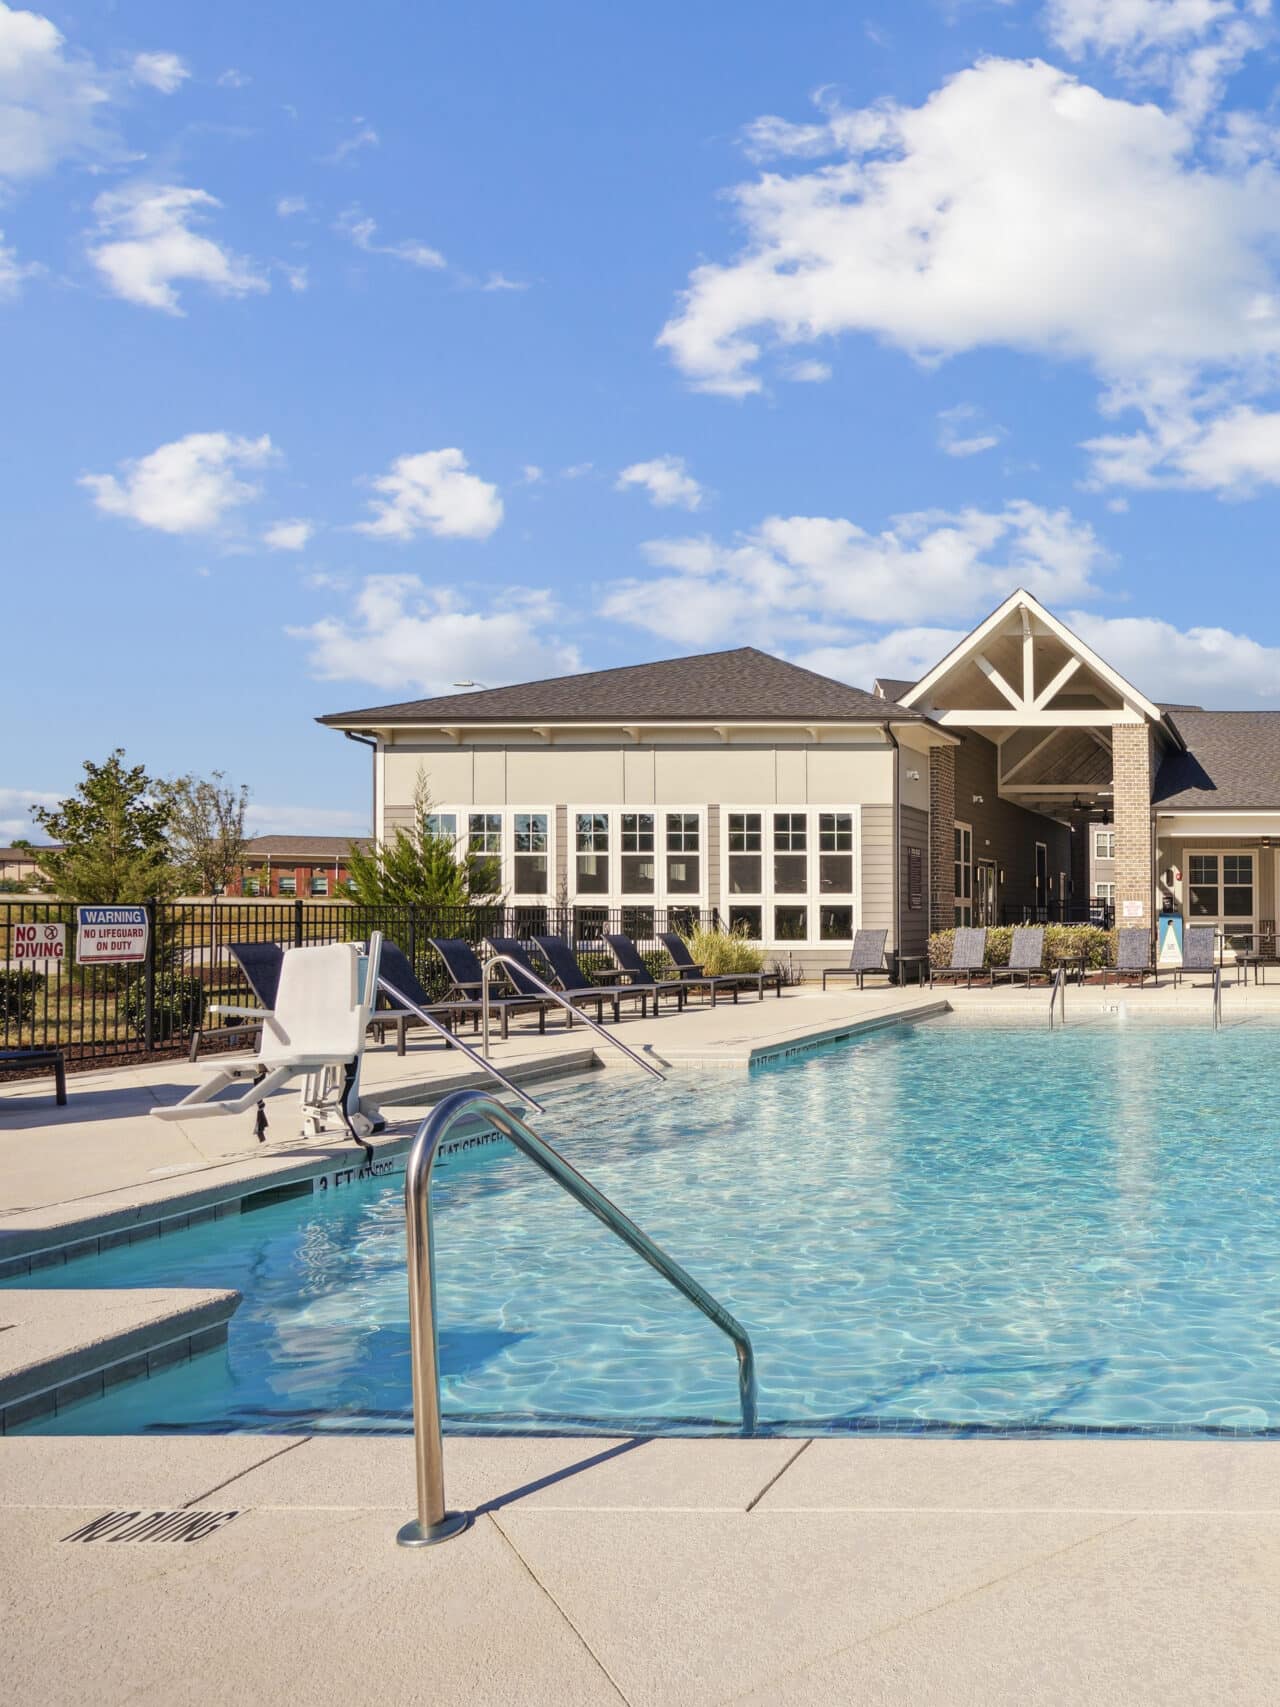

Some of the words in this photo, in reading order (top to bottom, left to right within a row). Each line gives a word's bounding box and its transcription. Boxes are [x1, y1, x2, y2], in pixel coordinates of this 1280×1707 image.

[86, 911, 141, 923] WARNING
[16, 927, 36, 941] NO
[84, 929, 95, 938] NO
[98, 928, 143, 938] LIFEGUARD
[15, 943, 63, 957] DIVING
[97, 942, 108, 951] ON
[111, 941, 132, 950] DUTY
[335, 1168, 354, 1187] FT
[59, 1511, 141, 1543] NO
[105, 1511, 239, 1542] DIVING
